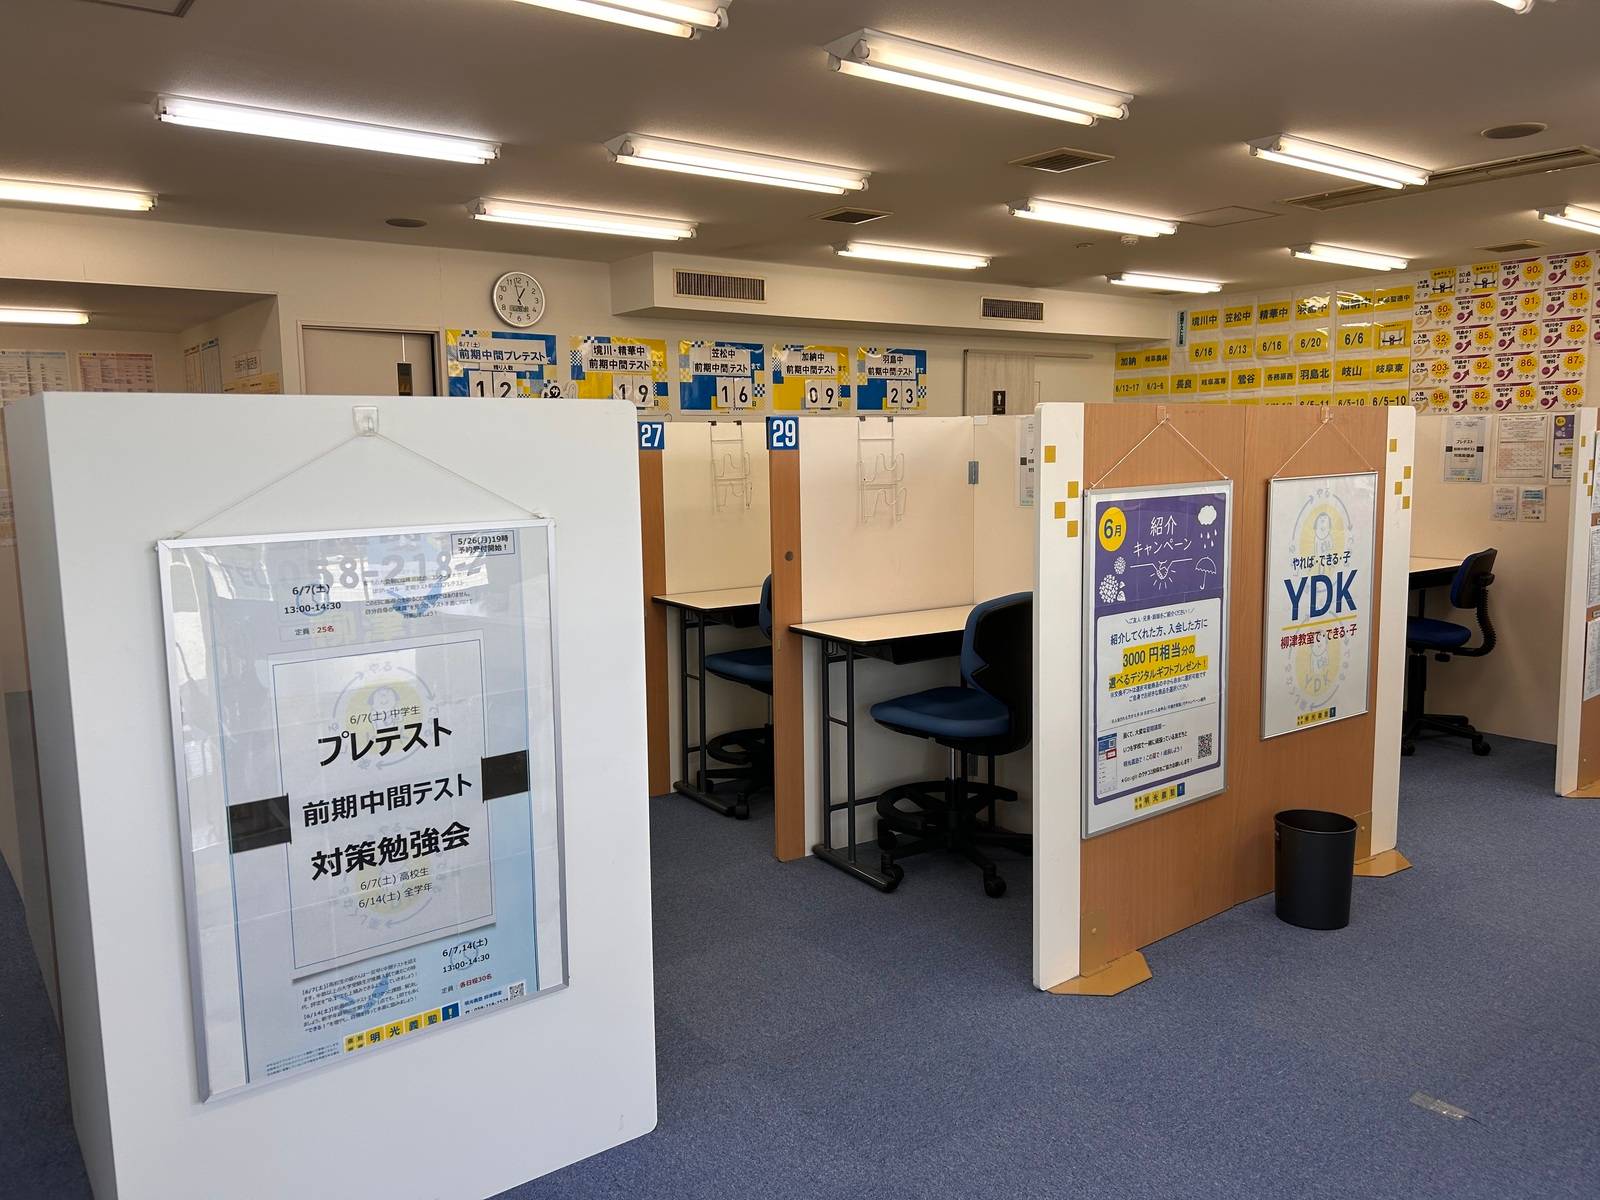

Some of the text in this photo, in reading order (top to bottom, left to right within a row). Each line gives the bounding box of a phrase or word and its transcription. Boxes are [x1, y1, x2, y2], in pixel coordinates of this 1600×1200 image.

[1225, 311, 1251, 323] 笠松中
[1260, 307, 1288, 320] 精華中
[1192, 315, 1218, 327] 境川中
[1300, 337, 1321, 348] 6/20
[1344, 332, 1364, 345] 6/6
[458, 348, 546, 362] 前期中間プレテスト
[593, 345, 646, 357] 境川・精華中
[711, 348, 736, 359] 笠松中
[801, 351, 825, 362] 加納中
[1228, 344, 1247, 355] 6/13
[588, 358, 650, 370] 前期中間テスト
[882, 355, 904, 365] 羽島中
[694, 362, 748, 373] 前期中間テスト
[786, 364, 836, 375] 前期中間テスト
[867, 367, 913, 377] 前期中間テスト
[1300, 368, 1330, 380] 羽島北
[1341, 365, 1362, 377] 岐山
[1376, 363, 1405, 374] 岐阜東
[1176, 379, 1192, 389] 長良
[1372, 395, 1407, 407] 6/5-10
[640, 423, 663, 448] 27
[772, 418, 797, 447] 29
[1103, 518, 1122, 539] 6月
[1149, 515, 1177, 537] 紹介
[457, 534, 509, 546] 5/26(月)19時
[458, 544, 507, 554] 予約受付開始！
[1132, 538, 1193, 558] キャンペーン
[1292, 550, 1351, 570] やれば・できる・子
[291, 583, 331, 597] 6/7(土)
[1284, 569, 1358, 621] YDK
[283, 601, 342, 615] 13:00-14:30
[1110, 618, 1209, 646] 紹介してくれた方、入会した方に
[1280, 624, 1358, 650] 柳津教室で・できる・子
[1122, 641, 1196, 668] 3000 円相当分の
[1108, 659, 1207, 690] 選べるデジタルギフトプレゼント！
[349, 703, 421, 725] 6/7(土) 中学生
[317, 717, 453, 767] プレテスト
[301, 772, 473, 828] 前期中間テスト
[310, 820, 471, 881] 対策勉強会
[359, 866, 430, 891] 6/7(土) 高校生
[358, 881, 433, 909] 6/14(土) 全学年
[442, 937, 488, 957] 6/7,14(土)
[442, 953, 490, 973] 13:00-14:30
[369, 1013, 438, 1043] 明光義塾
